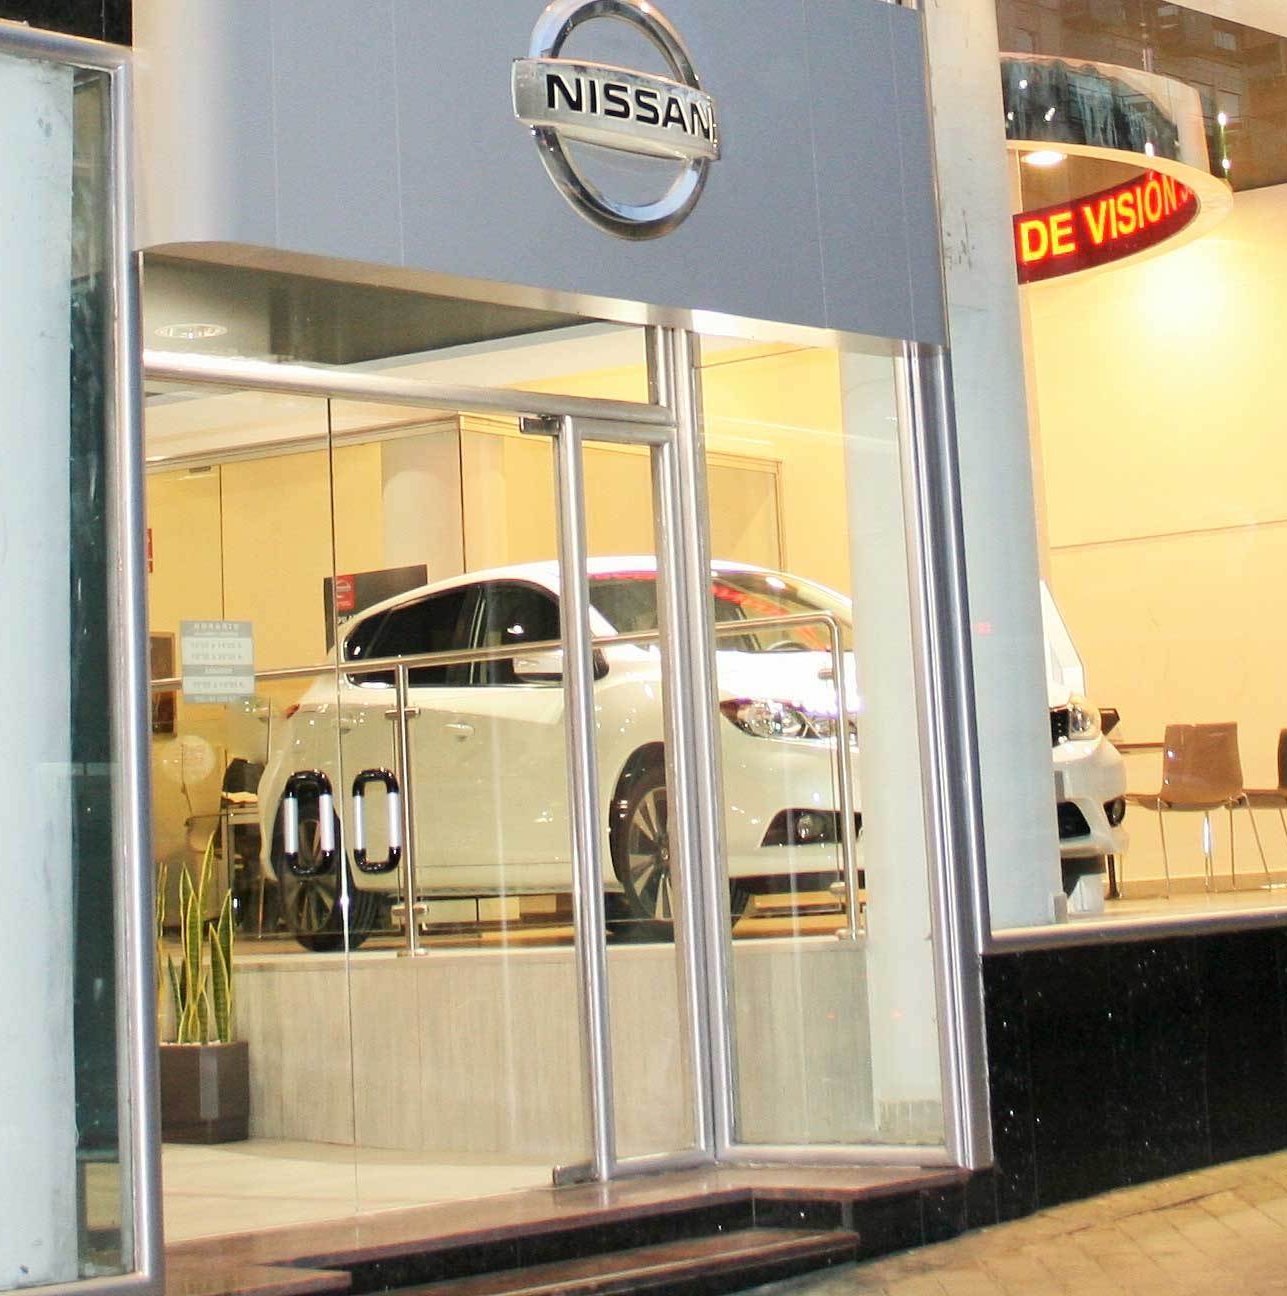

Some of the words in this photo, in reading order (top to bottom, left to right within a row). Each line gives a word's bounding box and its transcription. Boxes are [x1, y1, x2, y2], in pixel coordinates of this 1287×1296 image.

[546, 73, 713, 141] NISSAN
[1020, 210, 1076, 262] DE
[1084, 170, 1178, 244] VISIÓN
